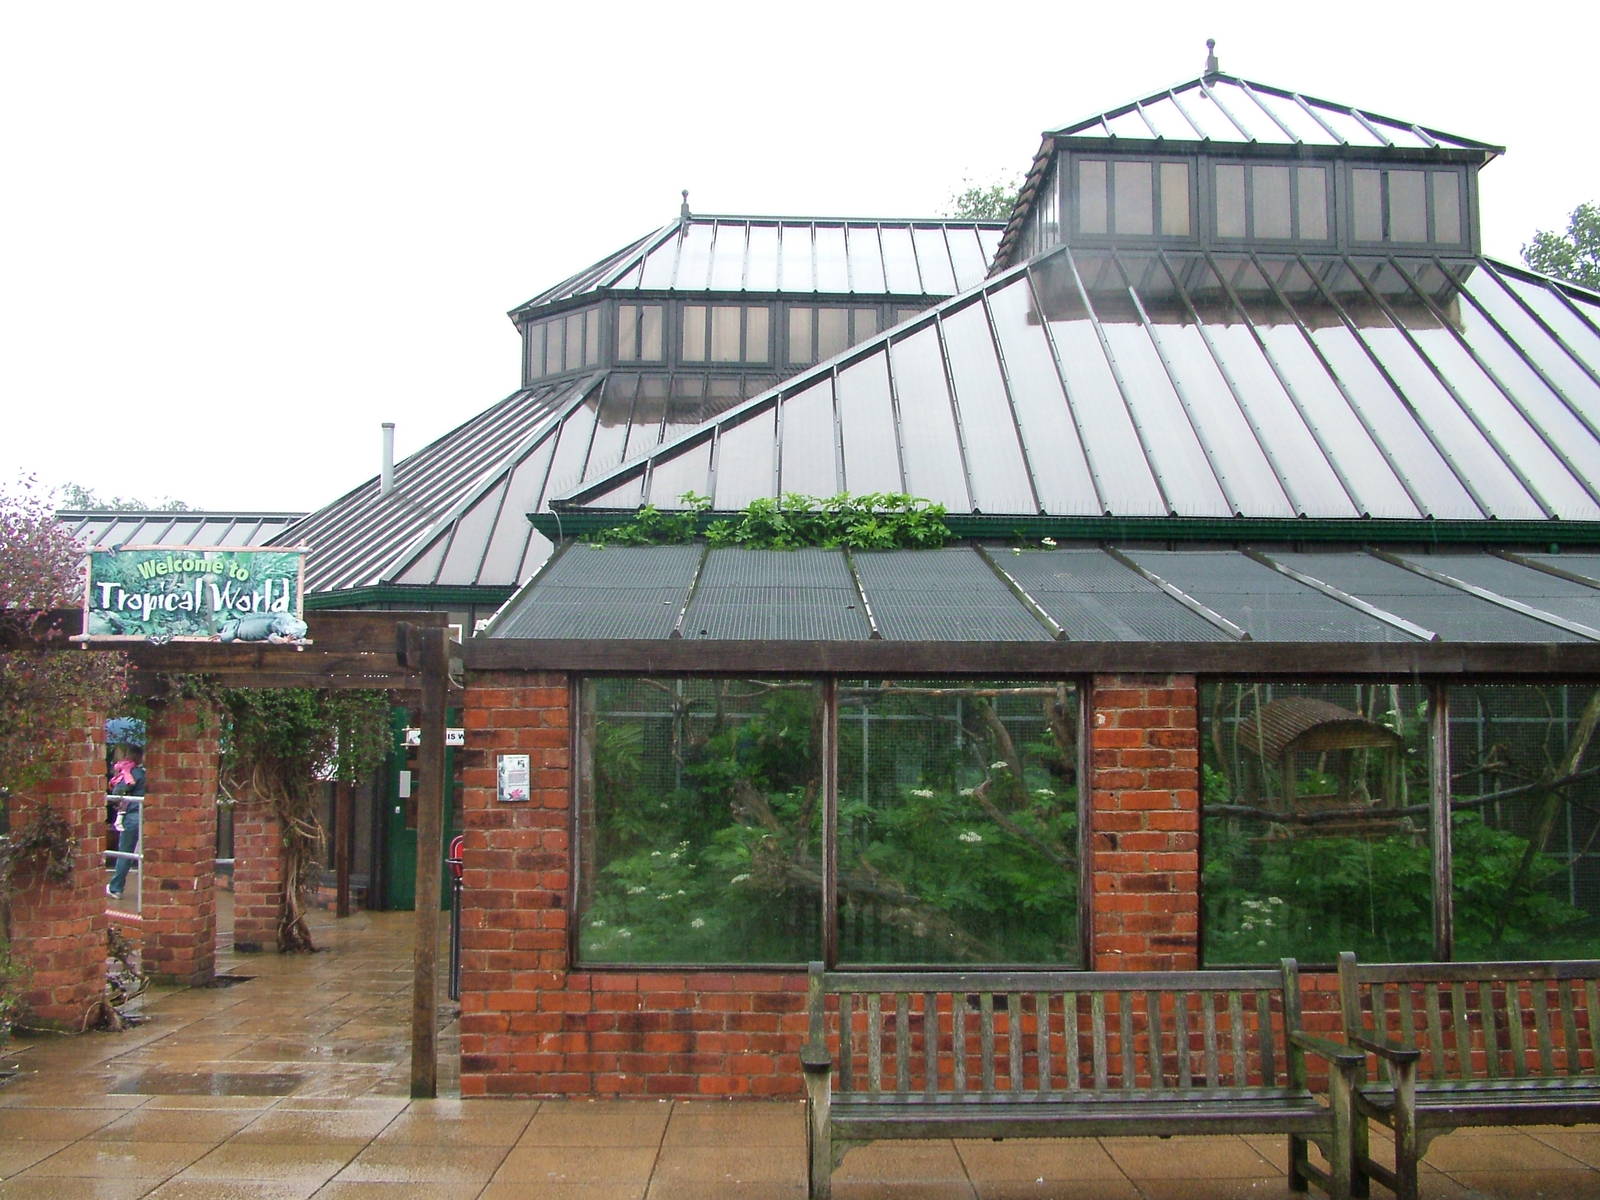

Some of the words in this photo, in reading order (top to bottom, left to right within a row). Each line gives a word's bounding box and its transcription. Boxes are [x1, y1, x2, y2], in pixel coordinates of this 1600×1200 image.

[137, 556, 224, 580] Welcome
[229, 561, 249, 581] to
[97, 578, 203, 621] Tropical
[209, 578, 290, 613] World
